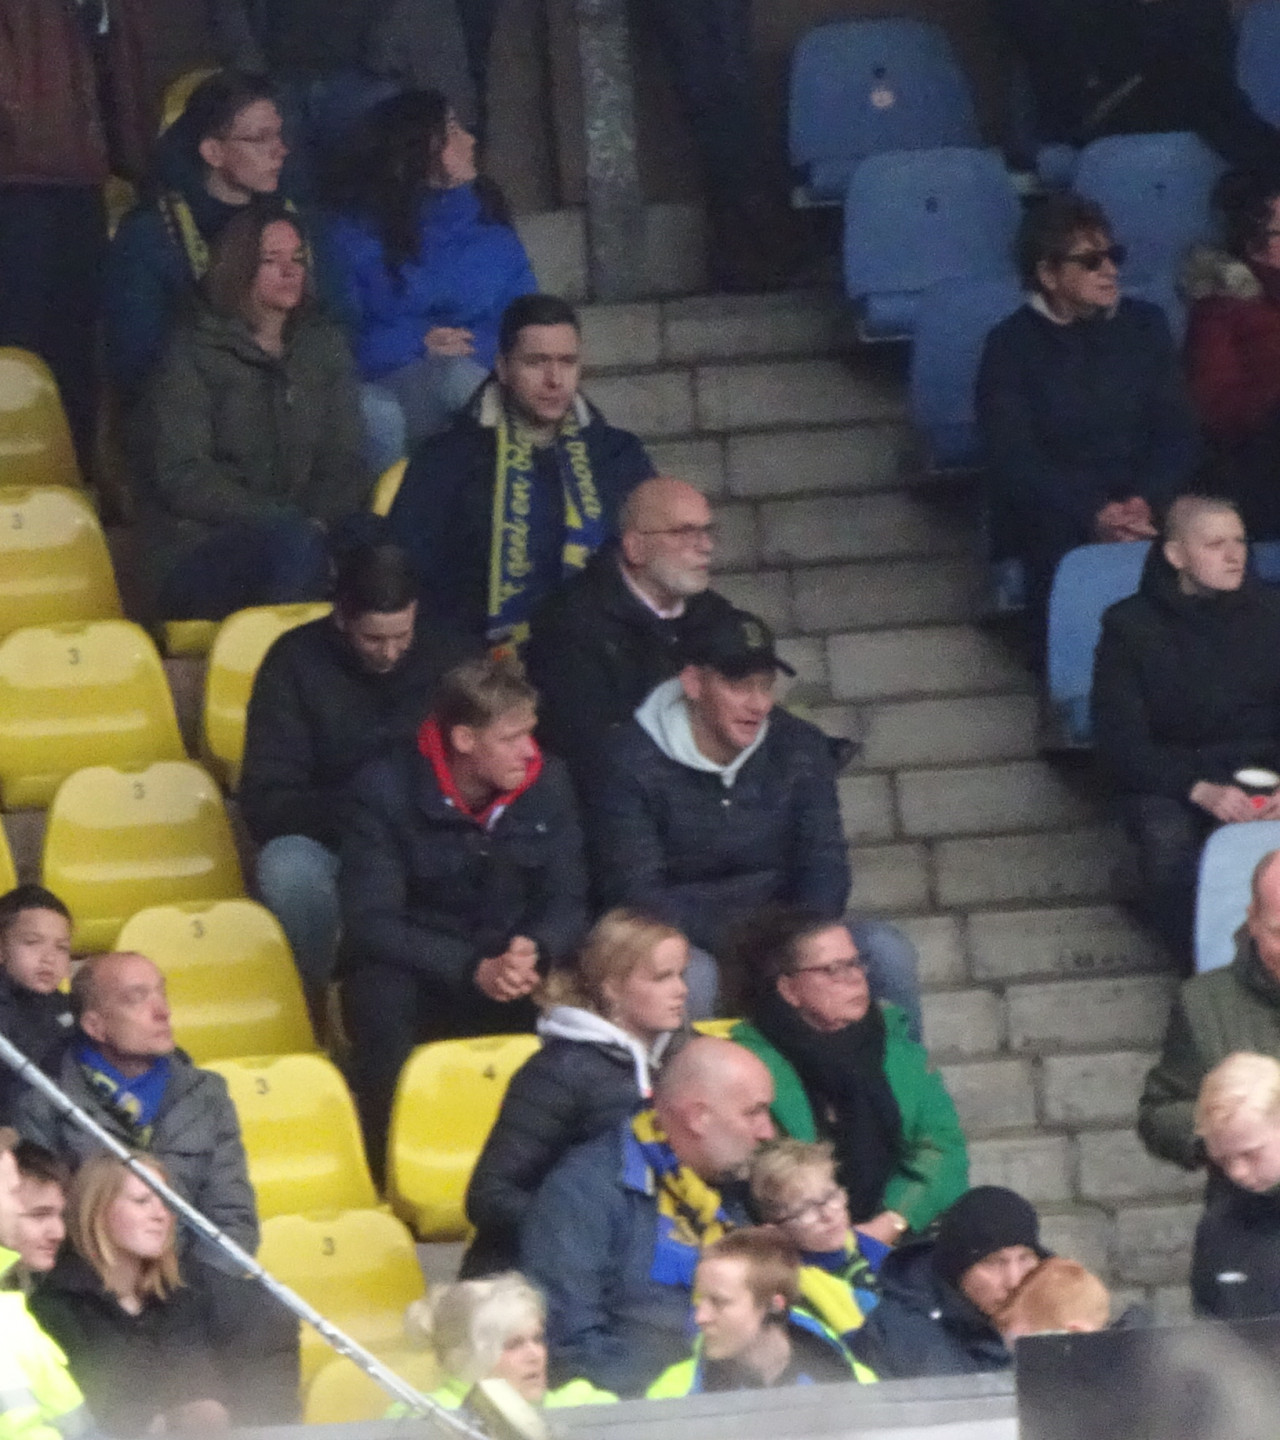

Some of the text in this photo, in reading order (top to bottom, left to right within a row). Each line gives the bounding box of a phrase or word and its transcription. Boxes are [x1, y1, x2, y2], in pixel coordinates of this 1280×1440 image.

[67, 646, 81, 665] 3
[132, 781, 146, 800] 3
[192, 920, 205, 939] 3
[255, 1076, 270, 1095] 3
[321, 1236, 336, 1256] 3
